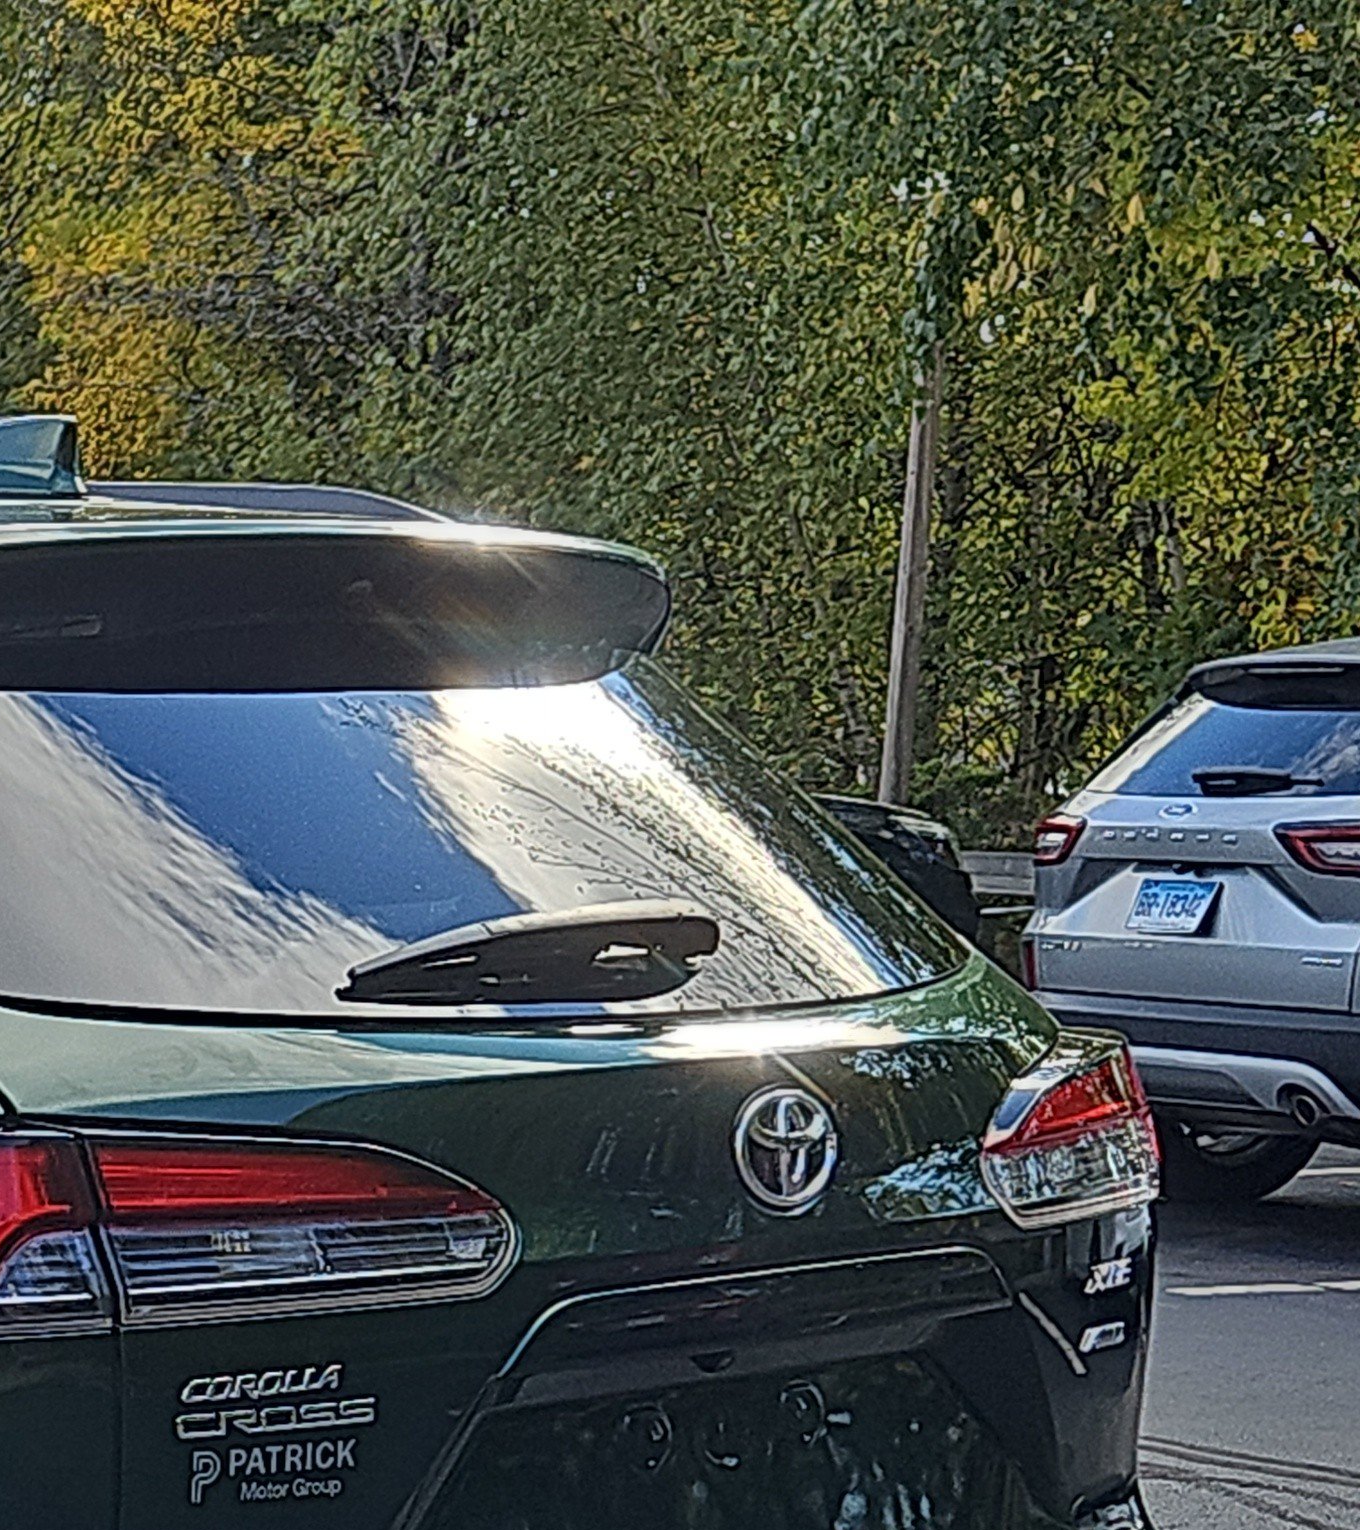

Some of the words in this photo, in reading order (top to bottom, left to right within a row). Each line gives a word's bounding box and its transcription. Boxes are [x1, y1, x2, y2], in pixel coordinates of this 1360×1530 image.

[181, 1364, 342, 1403] COROLLA
[176, 1397, 376, 1439] CROSS
[229, 1439, 356, 1476] PATRICK
[240, 1481, 288, 1501] Motor
[292, 1478, 342, 1497] Group
